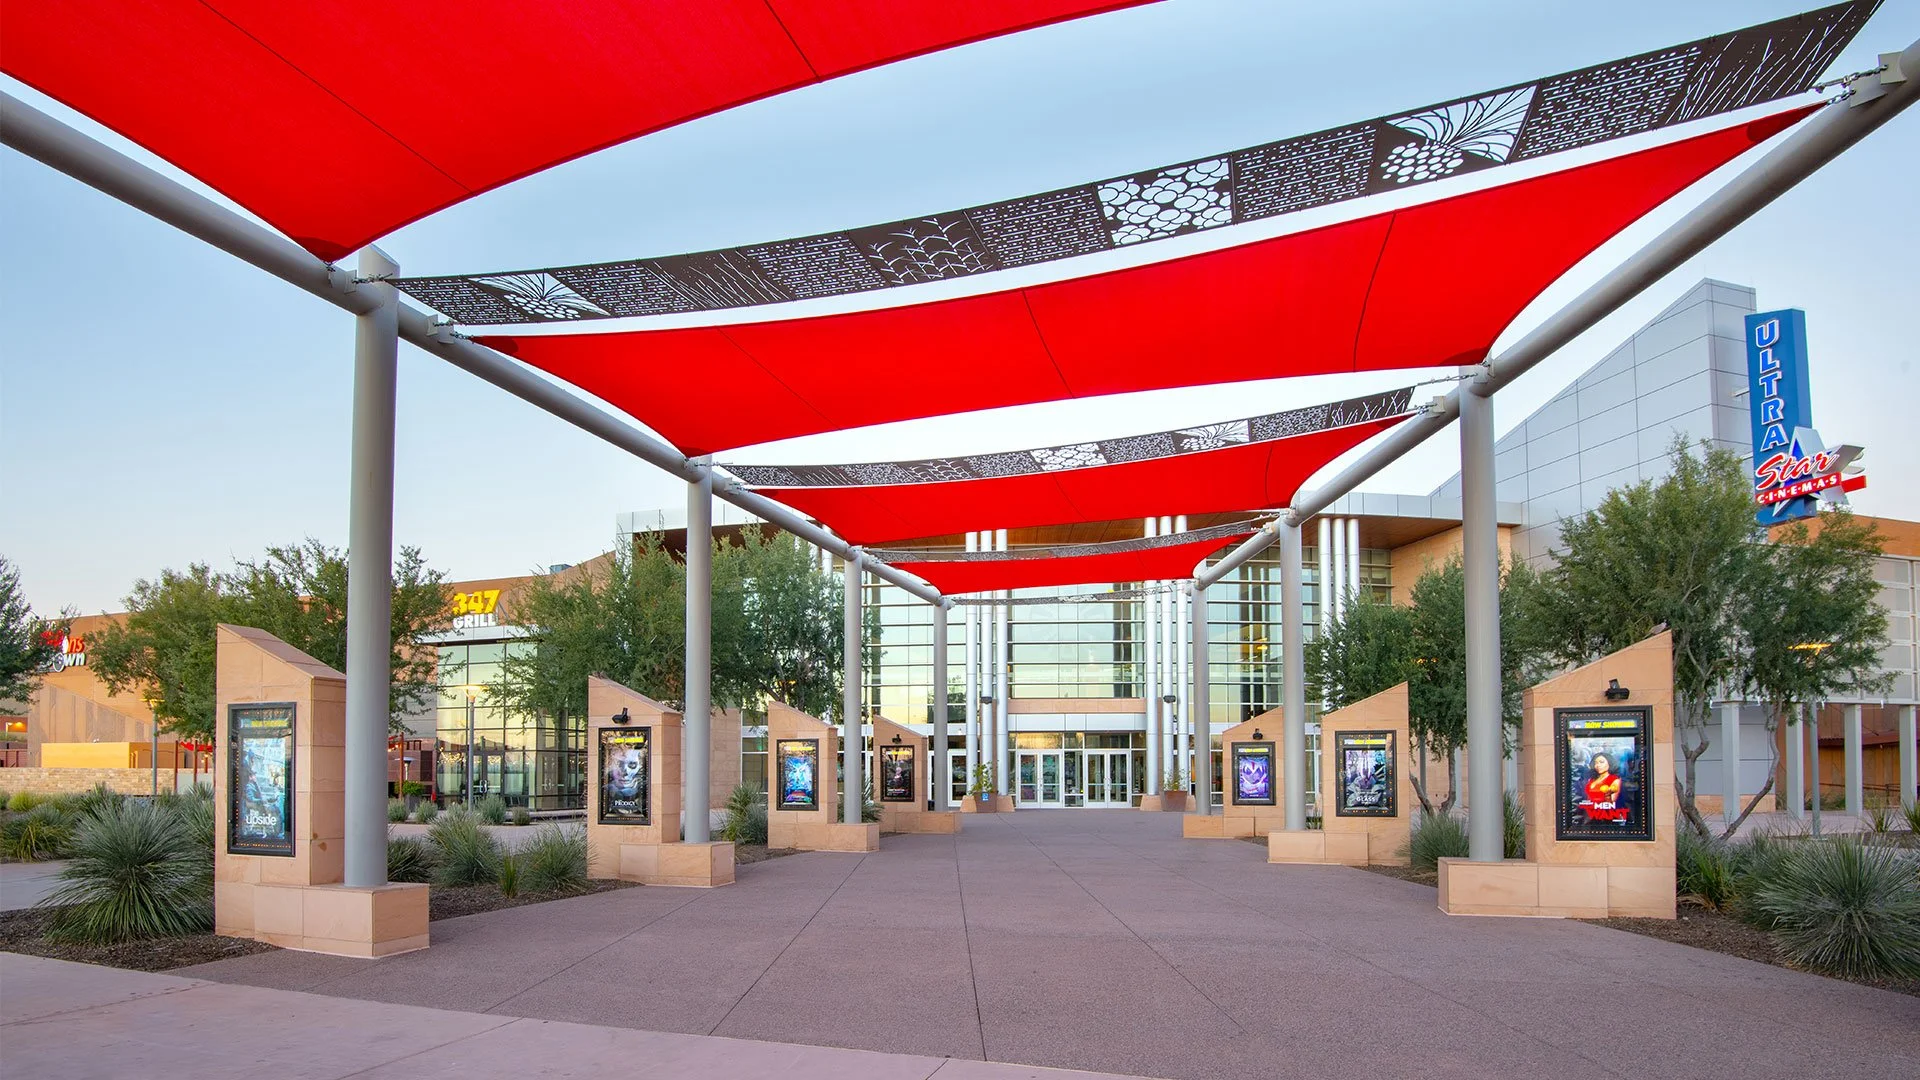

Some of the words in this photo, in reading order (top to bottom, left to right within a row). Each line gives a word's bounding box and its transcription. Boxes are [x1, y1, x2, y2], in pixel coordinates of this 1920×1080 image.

[1755, 319, 1790, 452] ULTRA
[1756, 452, 1840, 491] Star
[452, 589, 500, 615] 347
[452, 613, 498, 629] GRILL
[1587, 808, 1630, 820] WANT
[1594, 801, 1616, 810] MEN
